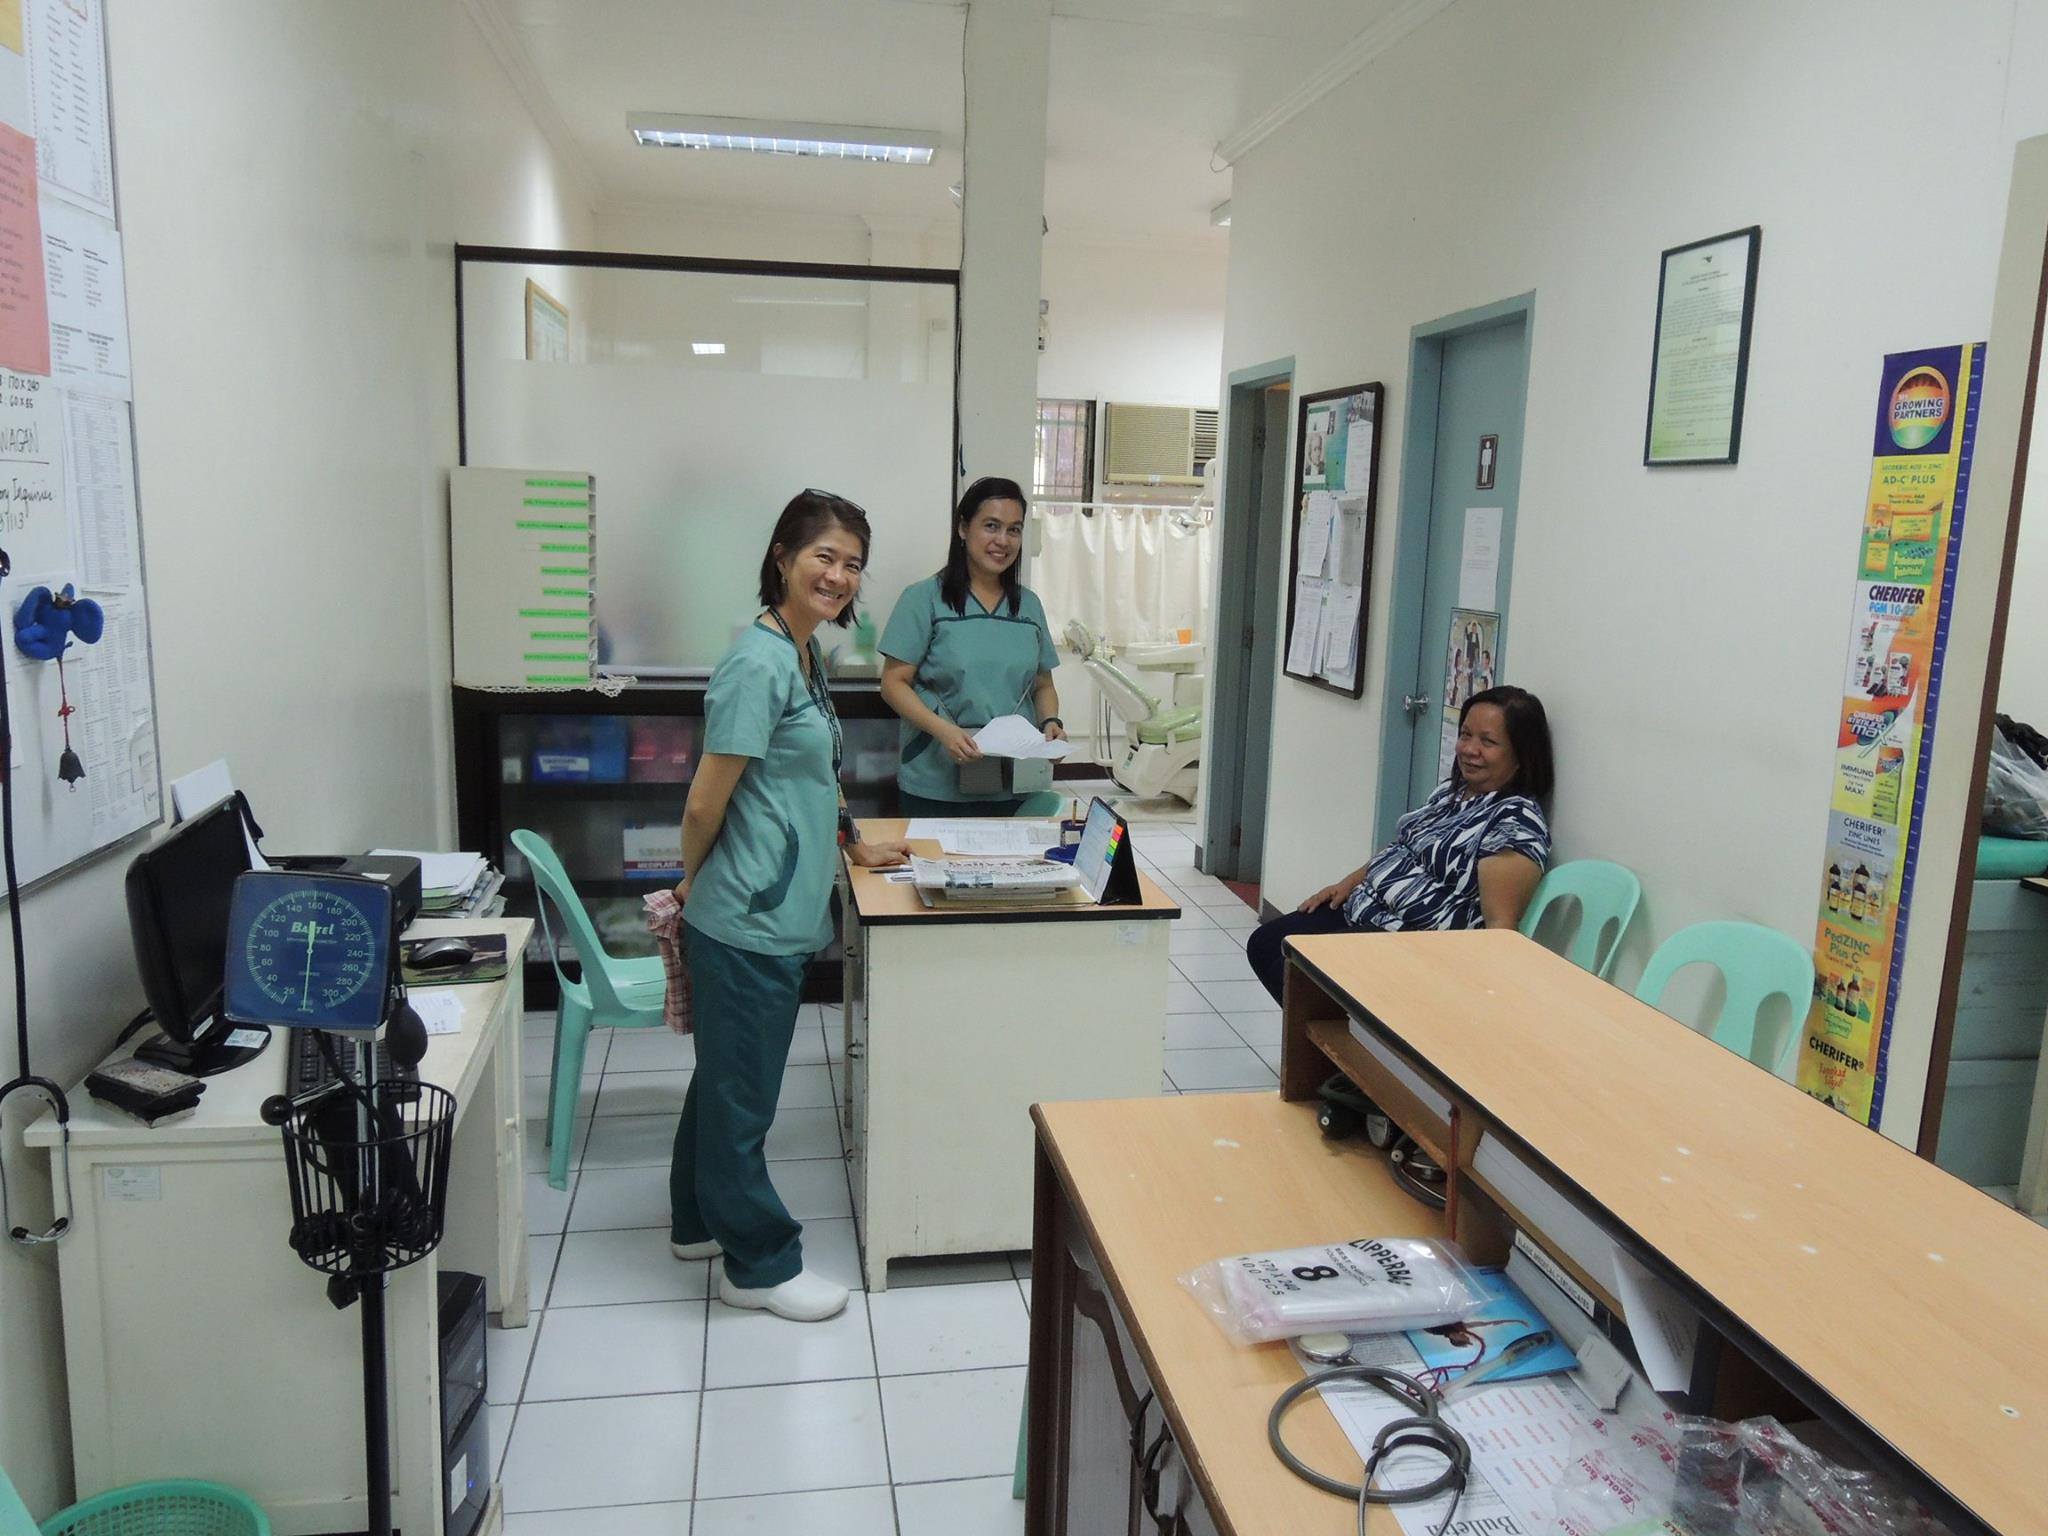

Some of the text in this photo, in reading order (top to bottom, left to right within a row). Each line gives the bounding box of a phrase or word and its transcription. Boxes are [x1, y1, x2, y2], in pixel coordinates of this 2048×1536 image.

[1895, 398, 1943, 411] GROWING
[1894, 408, 1942, 420] PARTNERS
[1911, 475, 1936, 485] PLUS
[1869, 585, 1925, 604] CHERIFER
[1869, 601, 1888, 614] PGM
[1841, 764, 1874, 778] IMMUNO
[286, 905, 302, 913] 140
[308, 902, 323, 910] 160
[327, 907, 342, 915] 180
[271, 914, 286, 922] 120
[341, 918, 357, 926] 200
[264, 929, 279, 937] 100
[344, 933, 361, 941] 220
[260, 944, 271, 952] 80
[346, 950, 363, 958] 240
[261, 958, 273, 966] 60
[341, 963, 359, 971] 260
[266, 974, 278, 982] 40
[336, 977, 353, 985] 280
[283, 987, 295, 995] 20
[322, 989, 339, 997] 300
[1237, 1256, 1285, 1296] 100 PCS
[1292, 1265, 1340, 1281] 8
[1425, 1516, 1523, 1536] Bulletn
